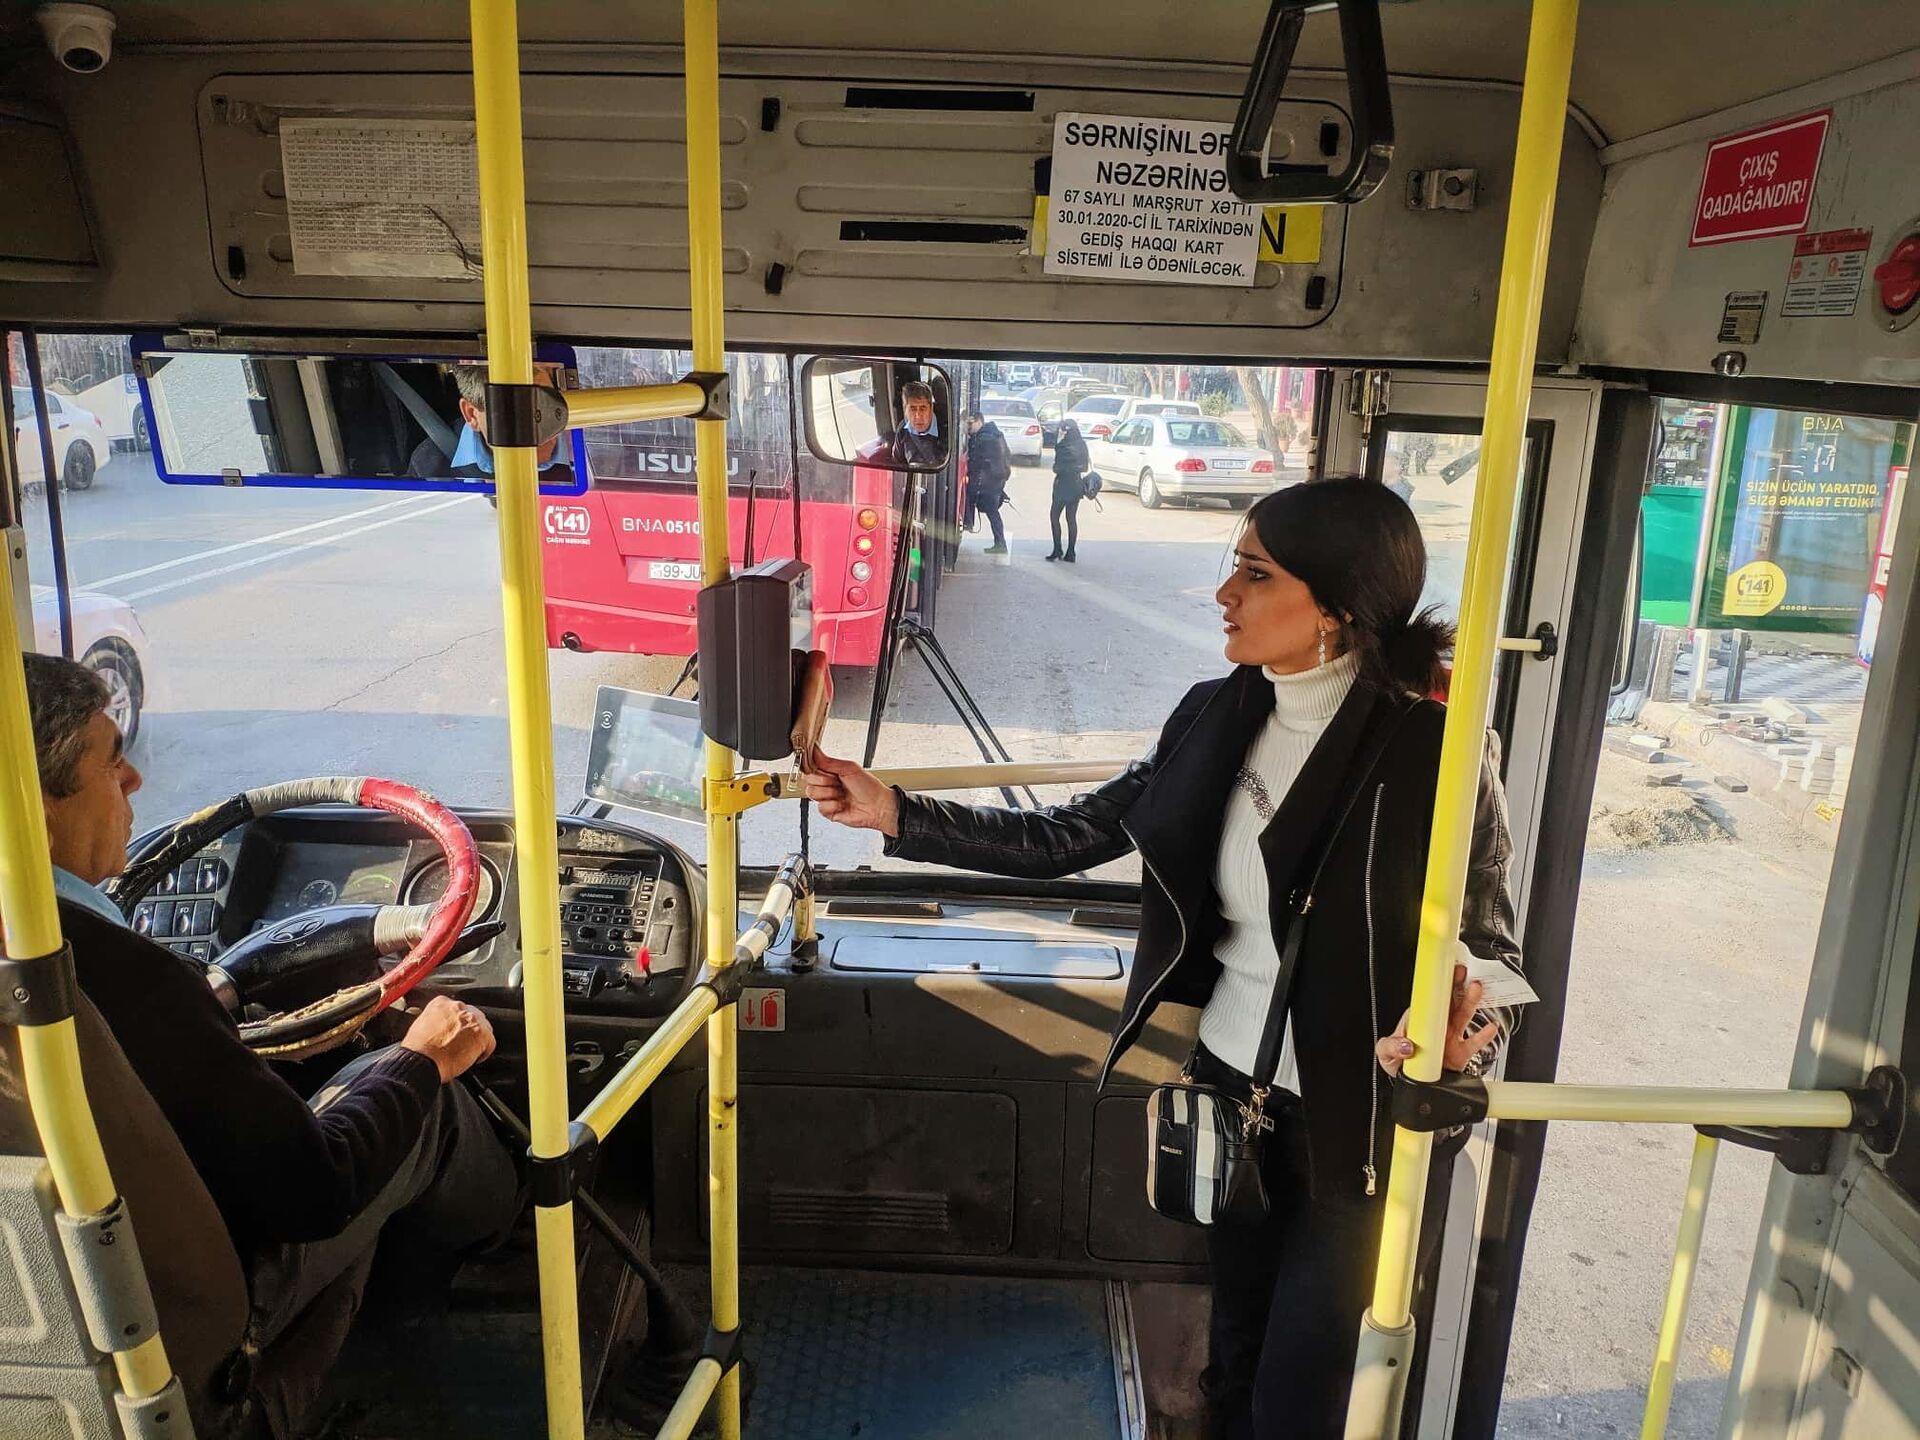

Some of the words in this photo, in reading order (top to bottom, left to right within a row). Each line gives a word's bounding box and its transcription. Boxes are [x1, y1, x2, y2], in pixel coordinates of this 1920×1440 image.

[1096, 161, 1232, 193] NƏZƏRİNƏ
[1739, 150, 1779, 187] ÇIXIŞ
[1064, 189, 1079, 204] 67
[1083, 190, 1125, 206] SAYLI
[1132, 195, 1203, 213] MARŞRUT
[1702, 178, 1808, 220] QADAĞANDIR!
[1058, 210, 1148, 230] 30.01.2020-Cİ
[1150, 214, 1162, 230] İL
[1167, 216, 1254, 237] TARİXİNDƏN
[1080, 230, 1124, 251] GEDİŞ
[1131, 236, 1177, 252] HAQQI
[1184, 239, 1224, 255] KART
[1057, 248, 1112, 267] SİSTEMİ
[1120, 252, 1143, 269] İLƏ
[1148, 252, 1246, 277] ÖDƏNİLƏCƏK.
[1802, 416, 1845, 431] BNA
[638, 452, 739, 476] ISUU
[1782, 479, 1816, 495] ÜÇÜN
[554, 512, 585, 531] 141
[1745, 578, 1770, 594] 141
